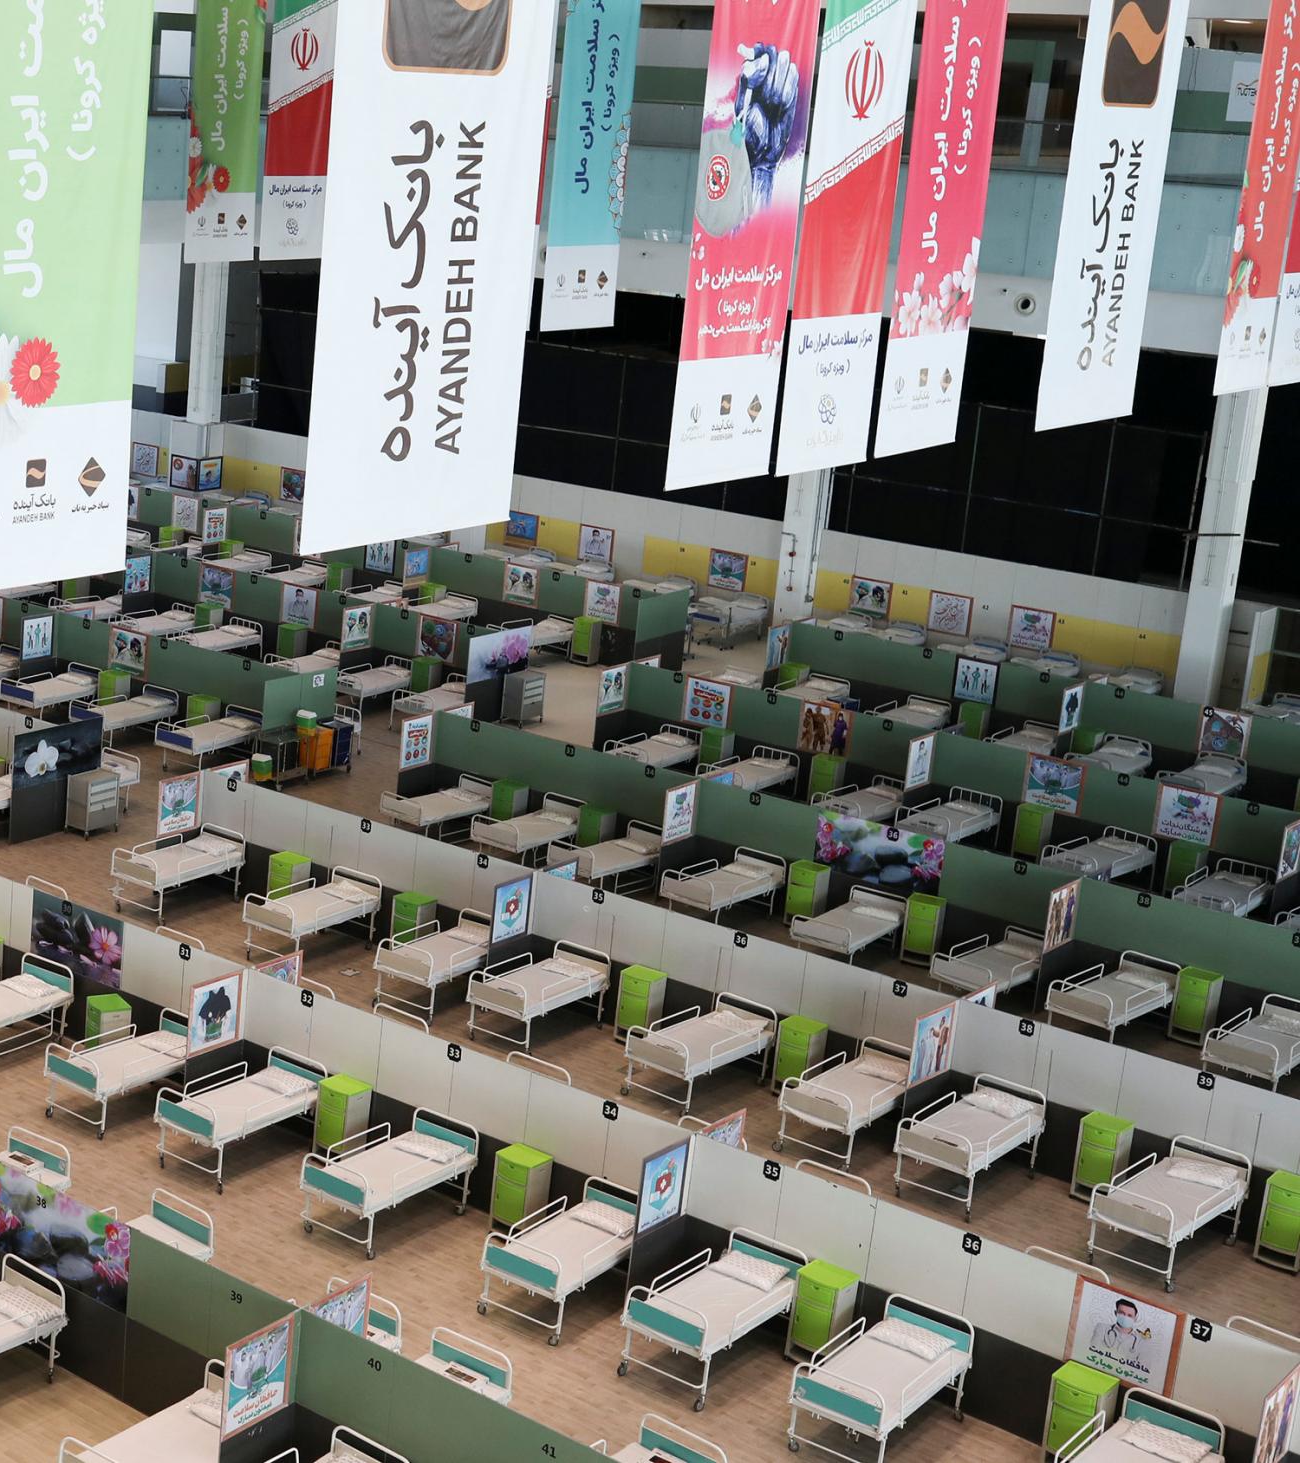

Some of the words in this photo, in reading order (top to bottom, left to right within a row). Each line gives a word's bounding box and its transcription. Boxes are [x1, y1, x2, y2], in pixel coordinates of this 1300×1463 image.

[586, 18, 600, 94] سلامت
[940, 15, 961, 122] سلامت
[213, 74, 228, 114] ایران
[1271, 46, 1288, 130] سلامت
[579, 101, 595, 150] ایران
[211, 120, 226, 151] مال
[8, 95, 50, 201] ایران
[930, 131, 949, 201] ایران
[1261, 138, 1275, 192] ایران
[450, 121, 486, 242] BANK
[575, 157, 590, 194] مال
[1092, 138, 1125, 254] بانک
[383, 120, 446, 290] بانک
[1253, 200, 1265, 242] مال
[921, 211, 939, 264] مال
[3, 218, 43, 298] مال
[1102, 233, 1132, 367] AYANDEH
[1121, 139, 1145, 222] BANK
[711, 266, 735, 290] ایران
[734, 265, 764, 283] سلامت
[763, 264, 783, 287] مرکز
[1076, 257, 1107, 371] آینده
[434, 259, 475, 455] AYANDEH
[373, 296, 430, 462] آینده
[12, 494, 34, 511] آینده
[37, 493, 57, 507] بانک
[11, 512, 39, 525] AYANDEH
[39, 511, 56, 521] BANK
[1205, 708, 1213, 716] 45
[566, 746, 574, 755] 33
[646, 767, 654, 776] 34
[228, 780, 236, 790] 32
[1119, 775, 1129, 784] 44
[751, 794, 760, 804] 35
[1248, 805, 1258, 814] 45
[362, 820, 370, 831] 33
[888, 830, 898, 839] 36
[478, 856, 488, 867] 34
[1015, 863, 1026, 873] 37
[593, 890, 603, 902] 35
[1139, 895, 1150, 906] 38
[63, 903, 71, 914] 30
[735, 934, 746, 946] 36
[181, 945, 190, 958] 31
[894, 982, 906, 995] 37
[302, 992, 312, 1005] 32
[1021, 1021, 1034, 1034] 38
[449, 1045, 460, 1060] 33
[1199, 1074, 1213, 1088] 39
[604, 1103, 617, 1118] 34
[765, 1163, 779, 1178] 35
[36, 1196, 46, 1208] 38
[964, 1235, 980, 1252] 36
[230, 1289, 242, 1304] 39
[1192, 1321, 1210, 1339] 37
[1088, 1345, 1119, 1362] سلامت
[367, 1358, 381, 1371] 40
[1086, 1355, 1114, 1370] مبارک
[1119, 1356, 1150, 1374] حافظان
[1115, 1366, 1149, 1383] عیدتون
[542, 1444, 556, 1459] 41
